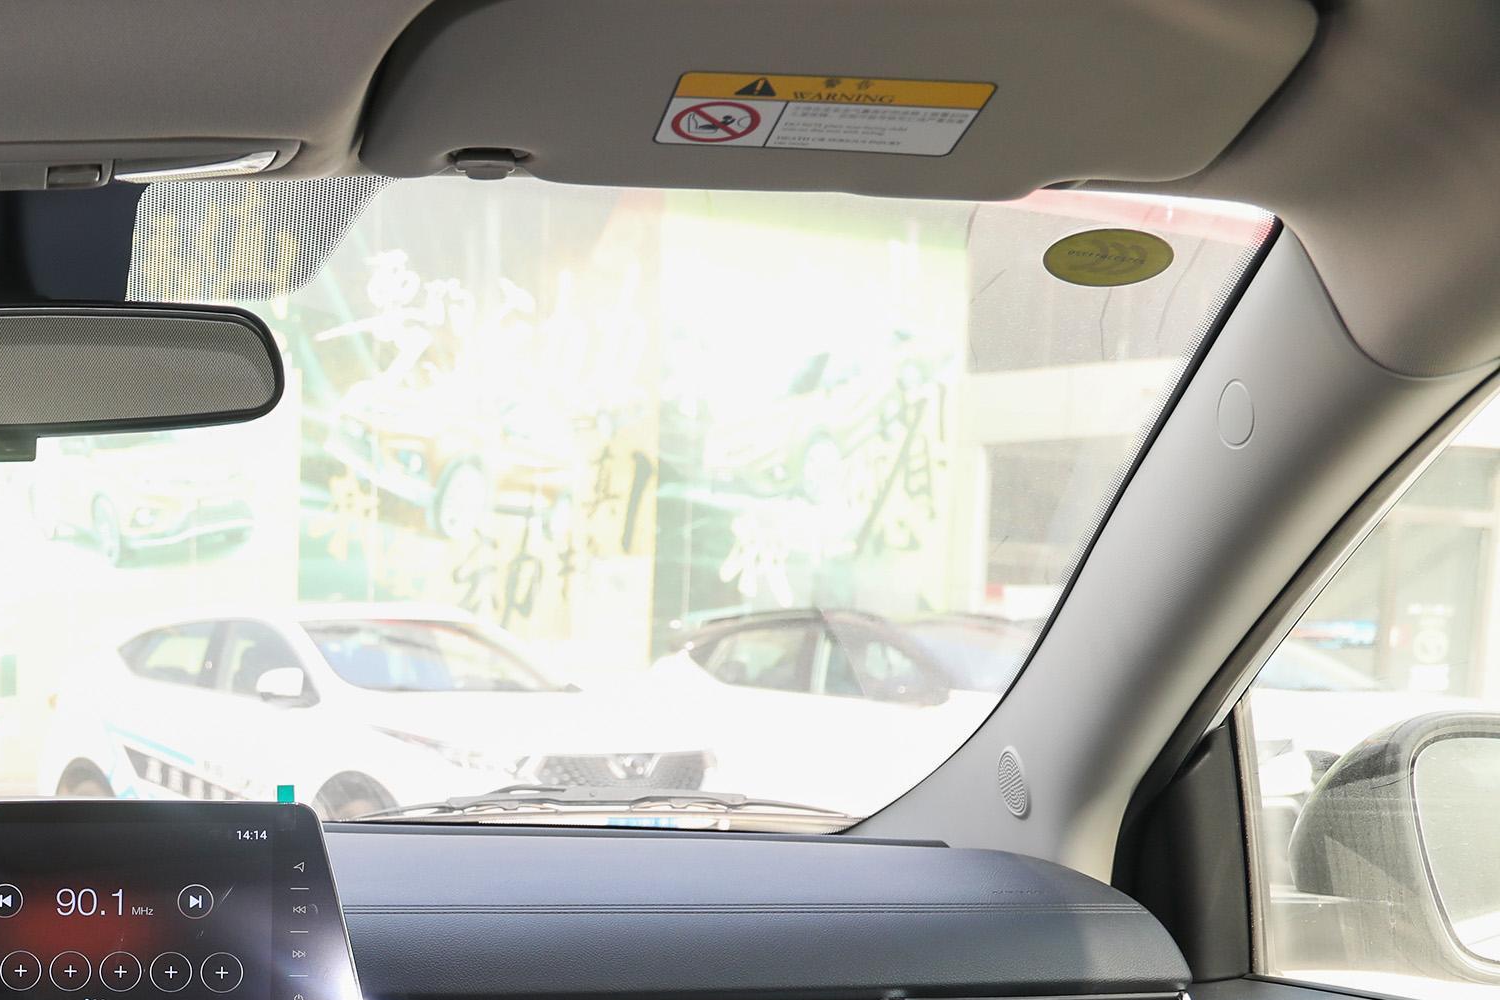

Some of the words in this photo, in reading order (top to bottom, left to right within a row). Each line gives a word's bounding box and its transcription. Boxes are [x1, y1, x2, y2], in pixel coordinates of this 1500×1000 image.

[792, 90, 896, 104] WARNING
[236, 830, 267, 841] 14:14
[56, 888, 125, 916] 90.1
[131, 905, 153, 916] MHz
